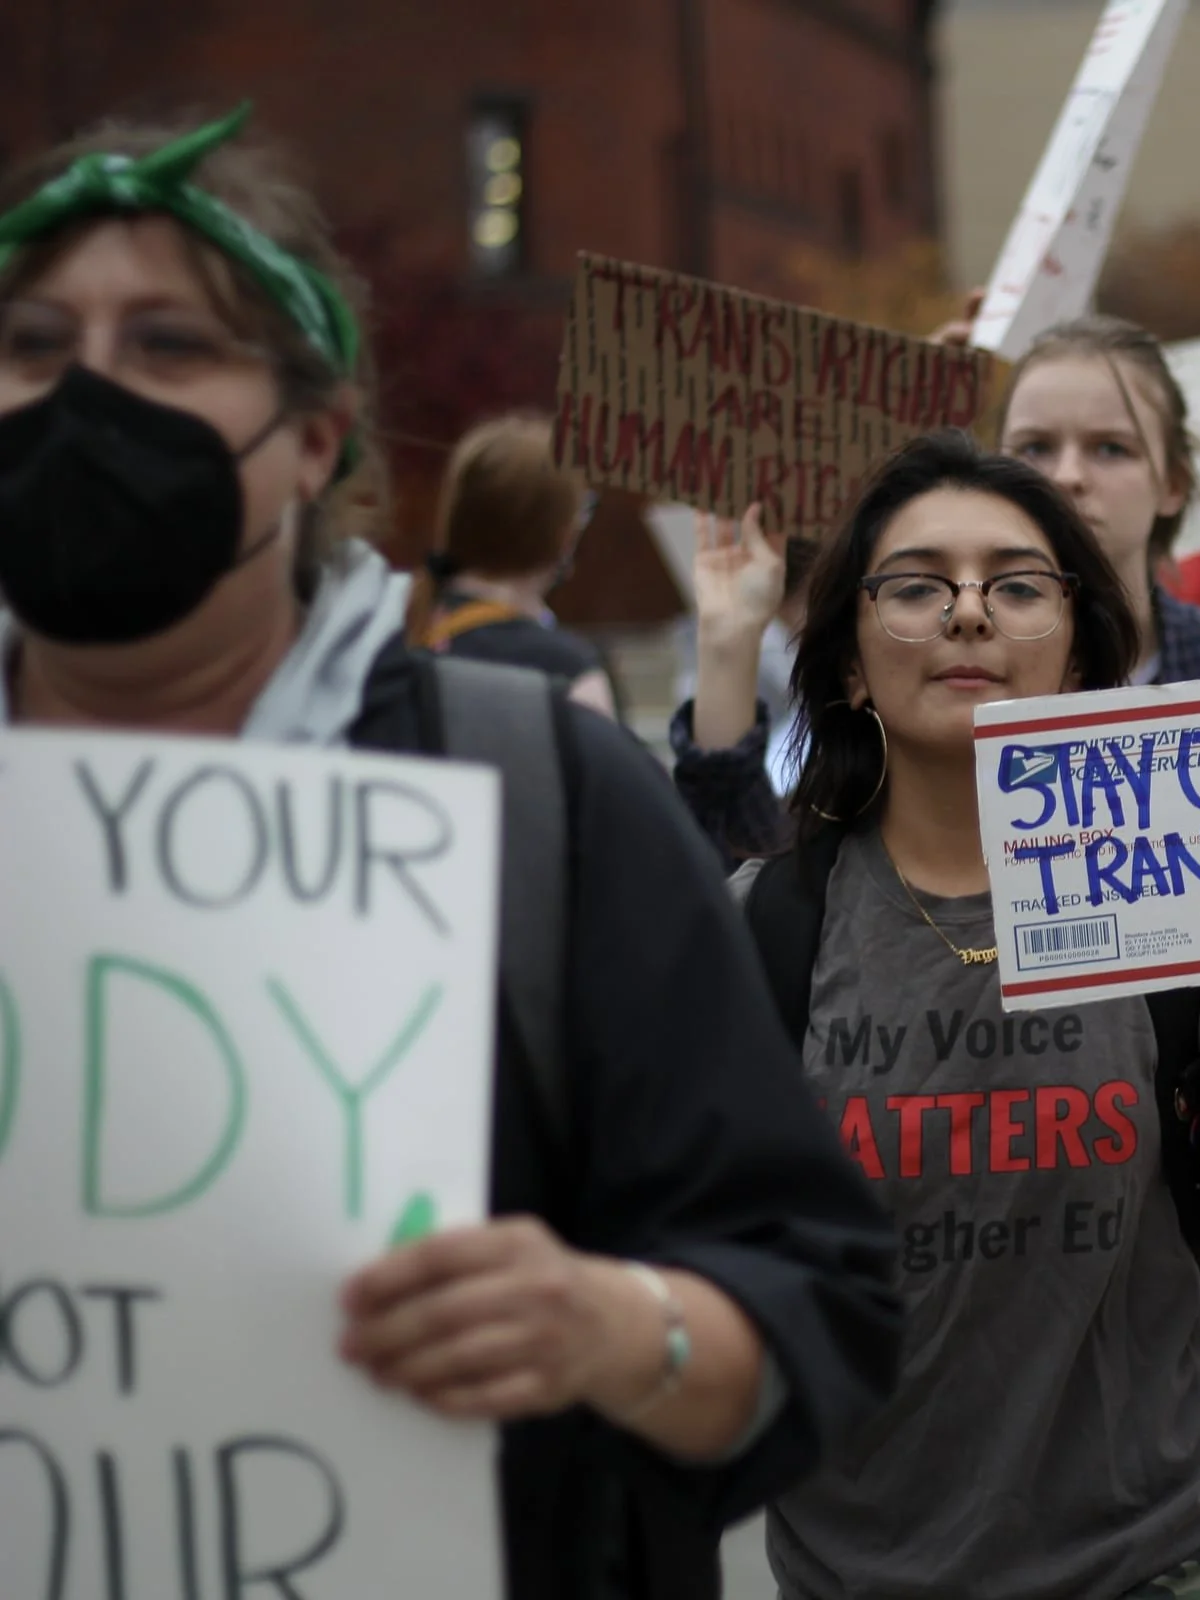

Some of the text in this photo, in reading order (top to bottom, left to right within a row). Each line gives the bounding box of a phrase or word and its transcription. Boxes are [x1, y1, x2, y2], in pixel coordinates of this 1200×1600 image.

[589, 267, 792, 389] TRANS
[553, 390, 733, 502] HUMAN
[707, 384, 838, 443] ARE
[998, 738, 1154, 830] STAY
[73, 756, 456, 938] YOUR
[1004, 832, 1074, 854] MAILING
[1079, 828, 1114, 846] BOX
[1011, 893, 1081, 913] TRACKED
[959, 947, 998, 965] Virgo
[825, 1009, 1084, 1076] My Voice
[817, 1080, 1140, 1180] ATTERS
[902, 1198, 1126, 1274] gher Ed
[0, 1272, 162, 1398] OT
